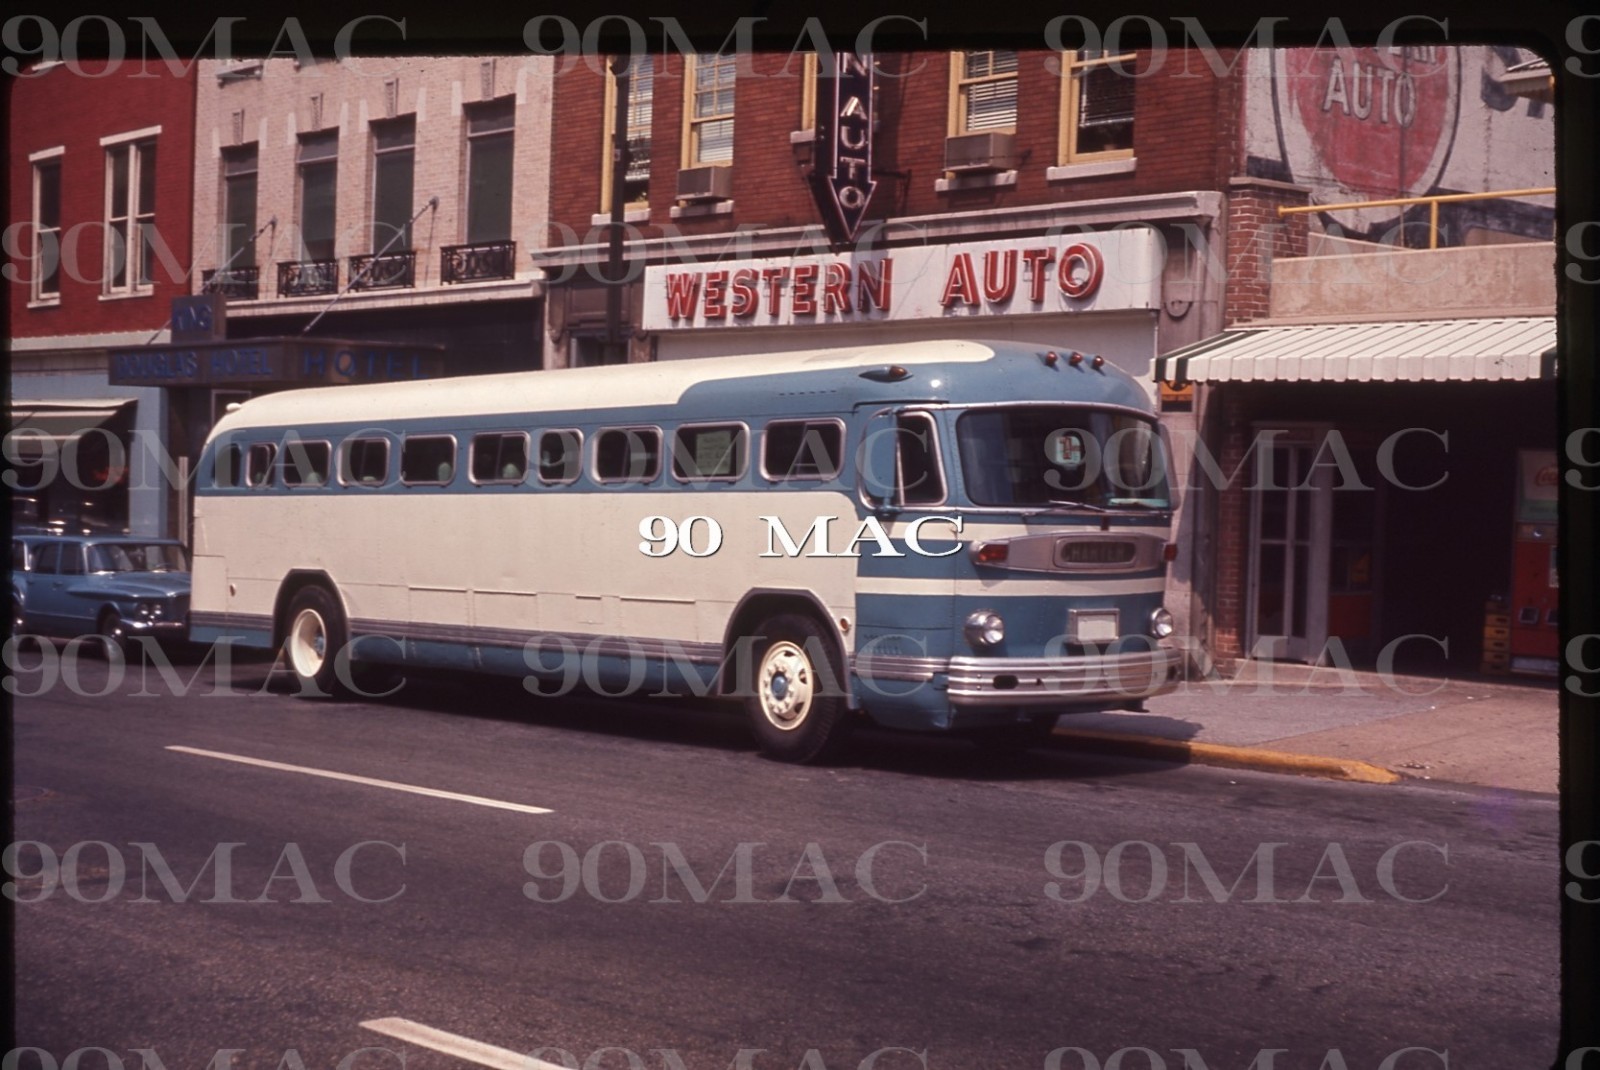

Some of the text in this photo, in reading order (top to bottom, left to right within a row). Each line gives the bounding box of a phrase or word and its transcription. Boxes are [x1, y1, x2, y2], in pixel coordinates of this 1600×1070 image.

[1322, 57, 1417, 128] AUTO
[839, 96, 868, 209] AUTO
[666, 242, 1104, 320] WESTERN AUTO
[210, 348, 273, 376] HOTEL
[303, 347, 432, 379] HOTEL
